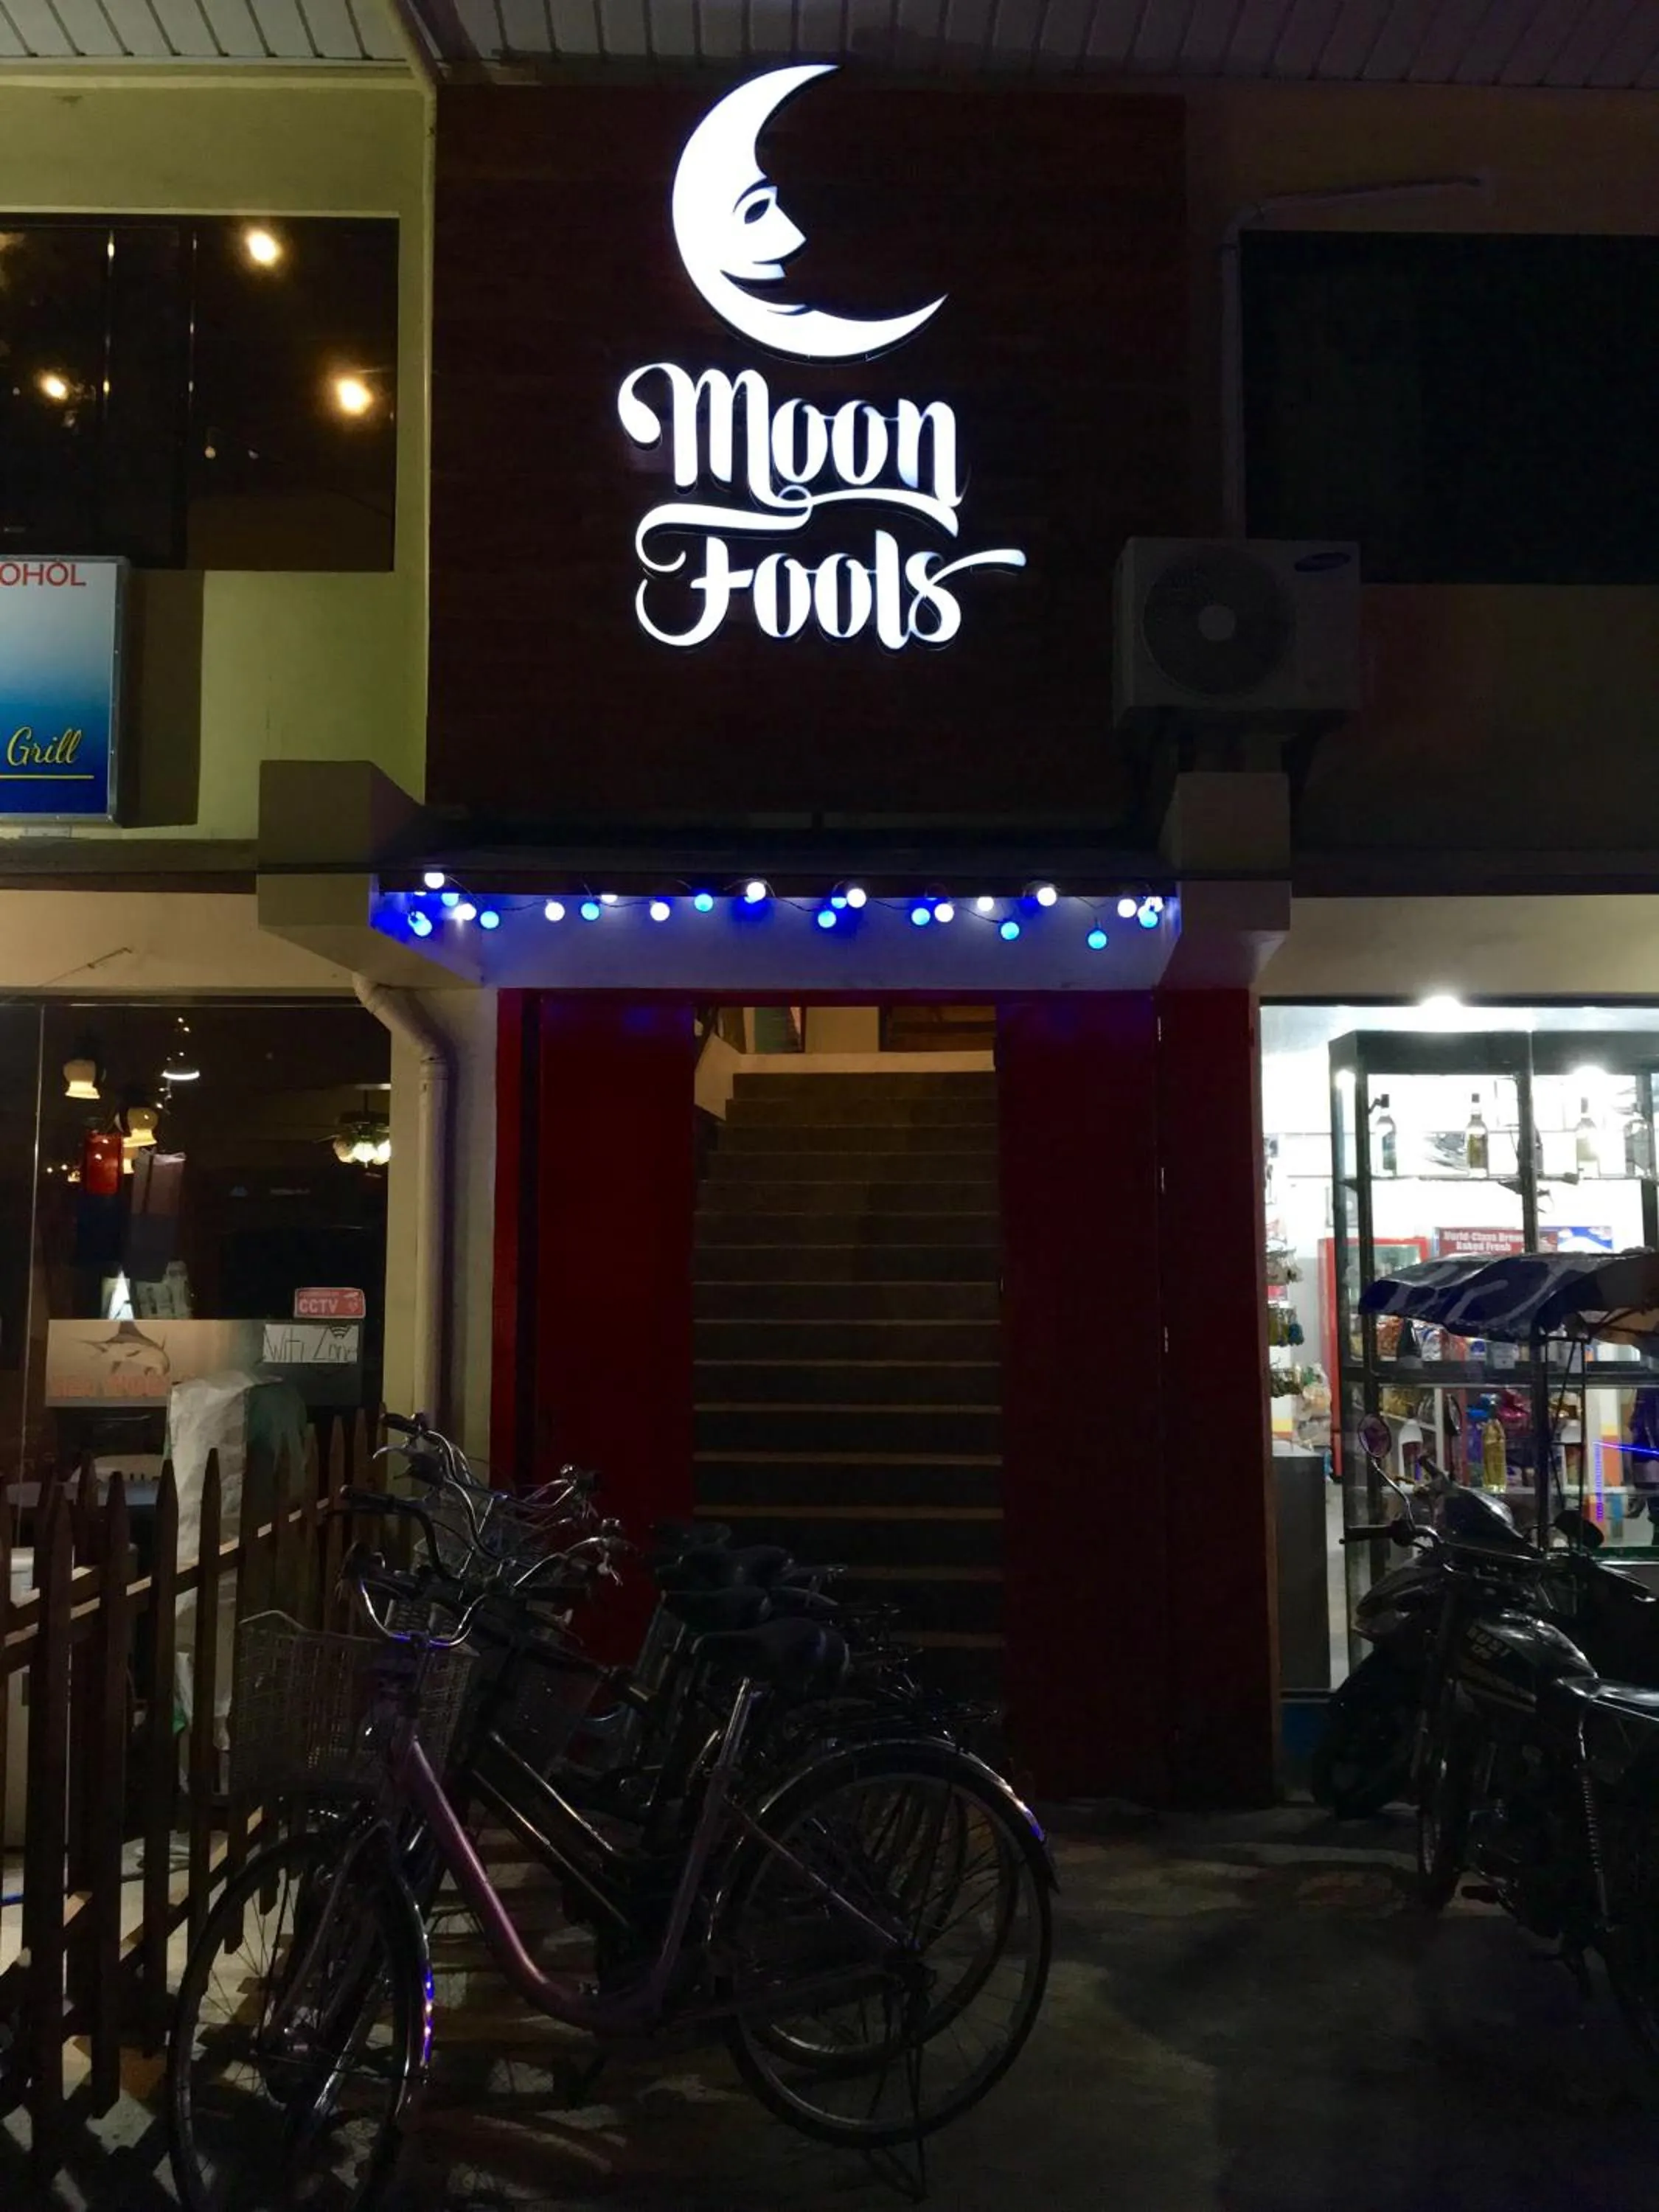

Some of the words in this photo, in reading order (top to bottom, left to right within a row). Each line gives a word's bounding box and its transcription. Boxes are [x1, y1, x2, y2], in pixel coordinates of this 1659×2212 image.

[617, 362, 961, 516] Moon
[636, 504, 1026, 650] Fools
[7, 726, 82, 766] Grill
[299, 1298, 339, 1315] CCTV
